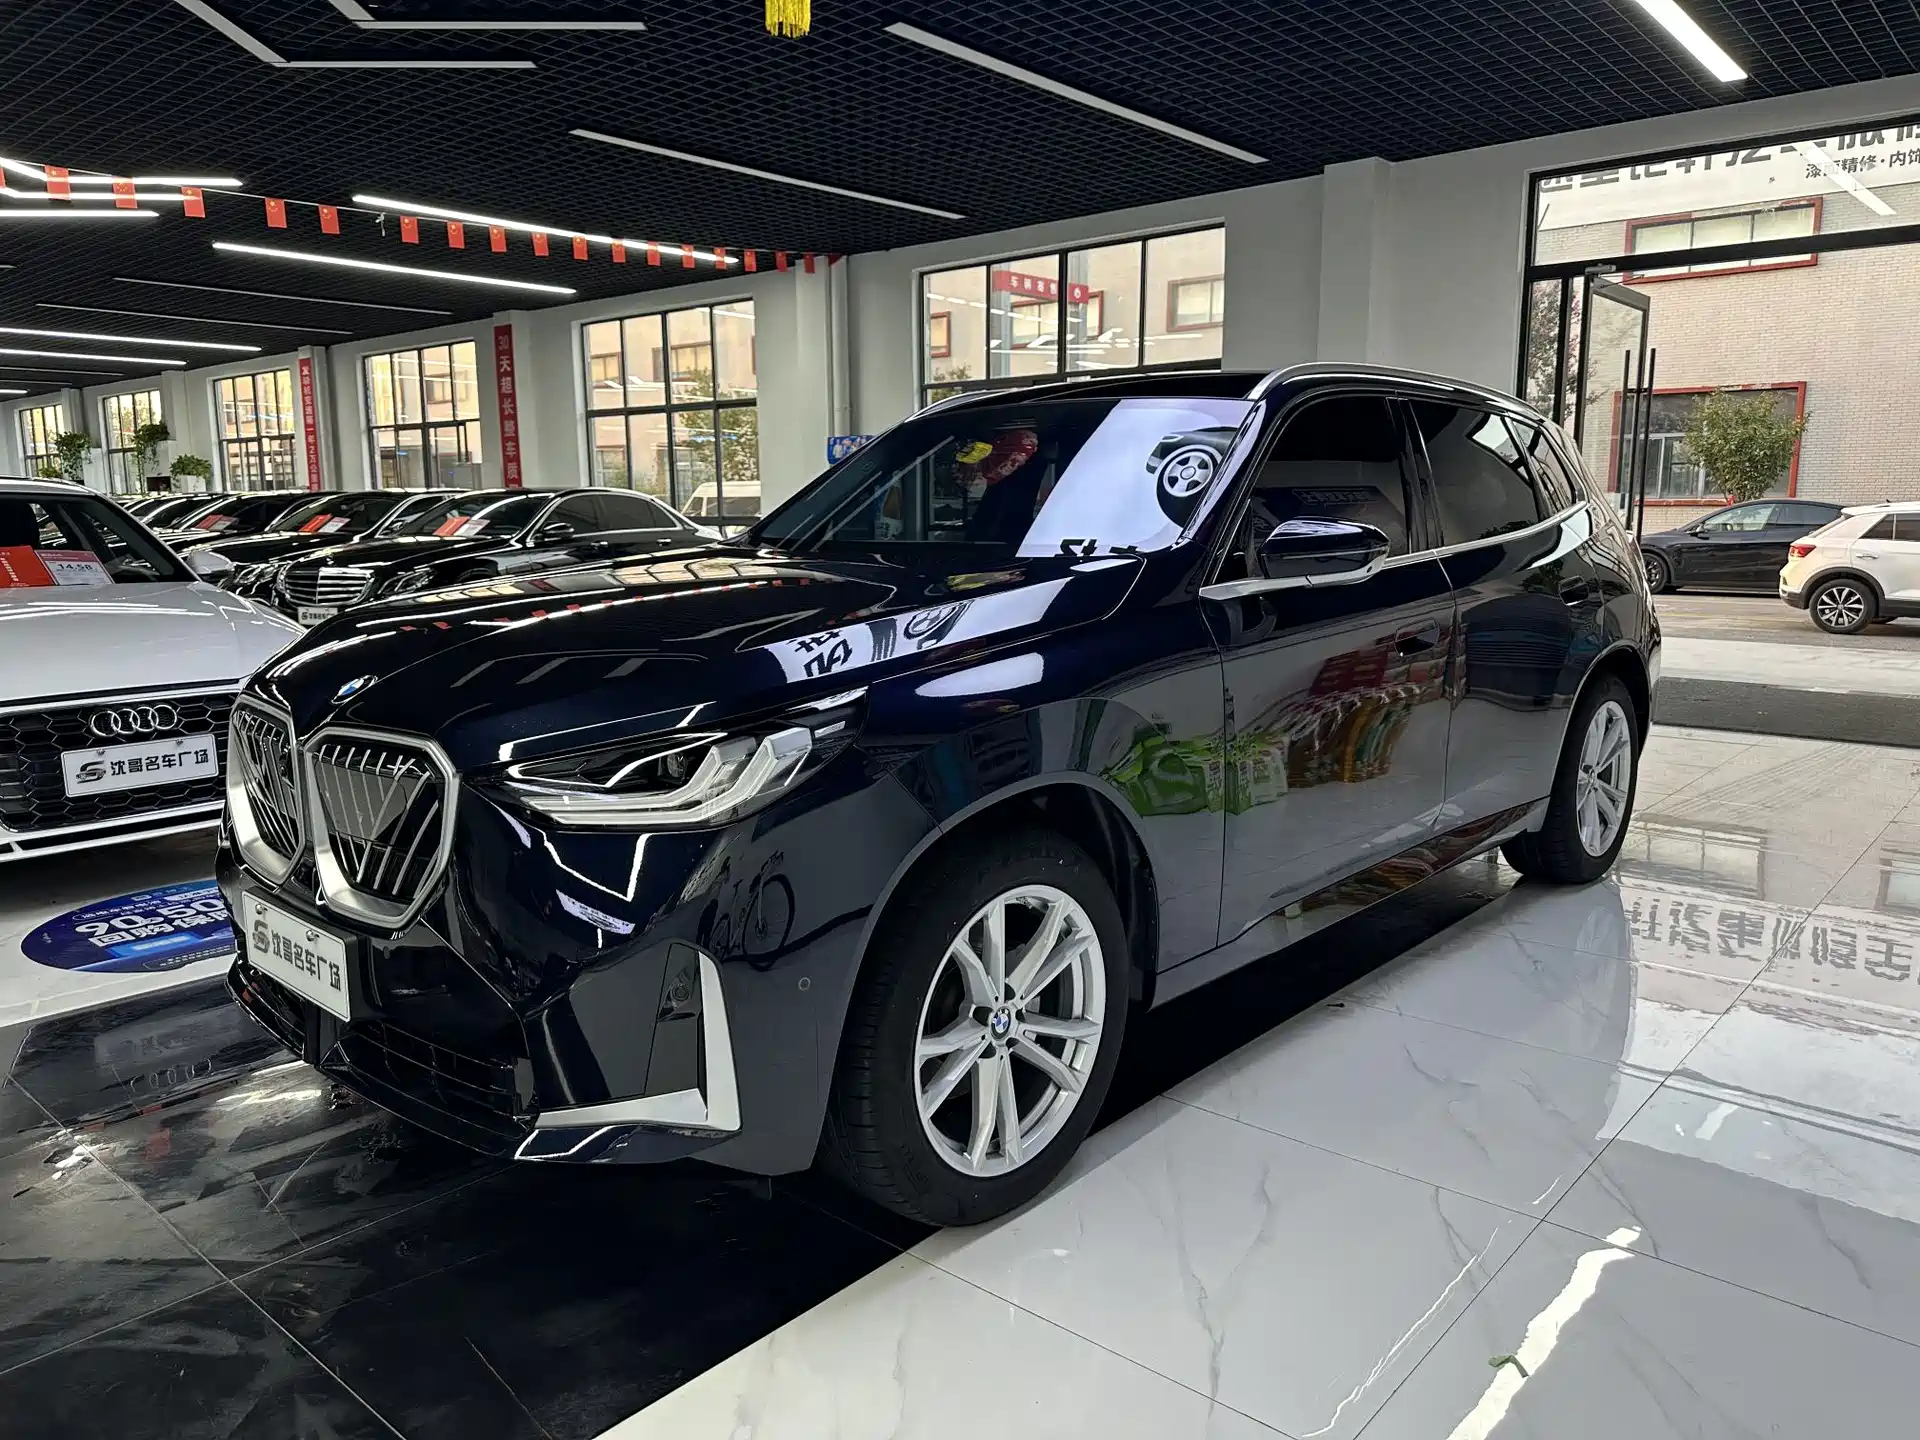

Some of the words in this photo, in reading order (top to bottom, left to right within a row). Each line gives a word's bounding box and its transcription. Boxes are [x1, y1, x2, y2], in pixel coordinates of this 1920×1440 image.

[110, 749, 209, 776] 沈哥名车广场
[271, 929, 341, 992] 沈哥名车广场
